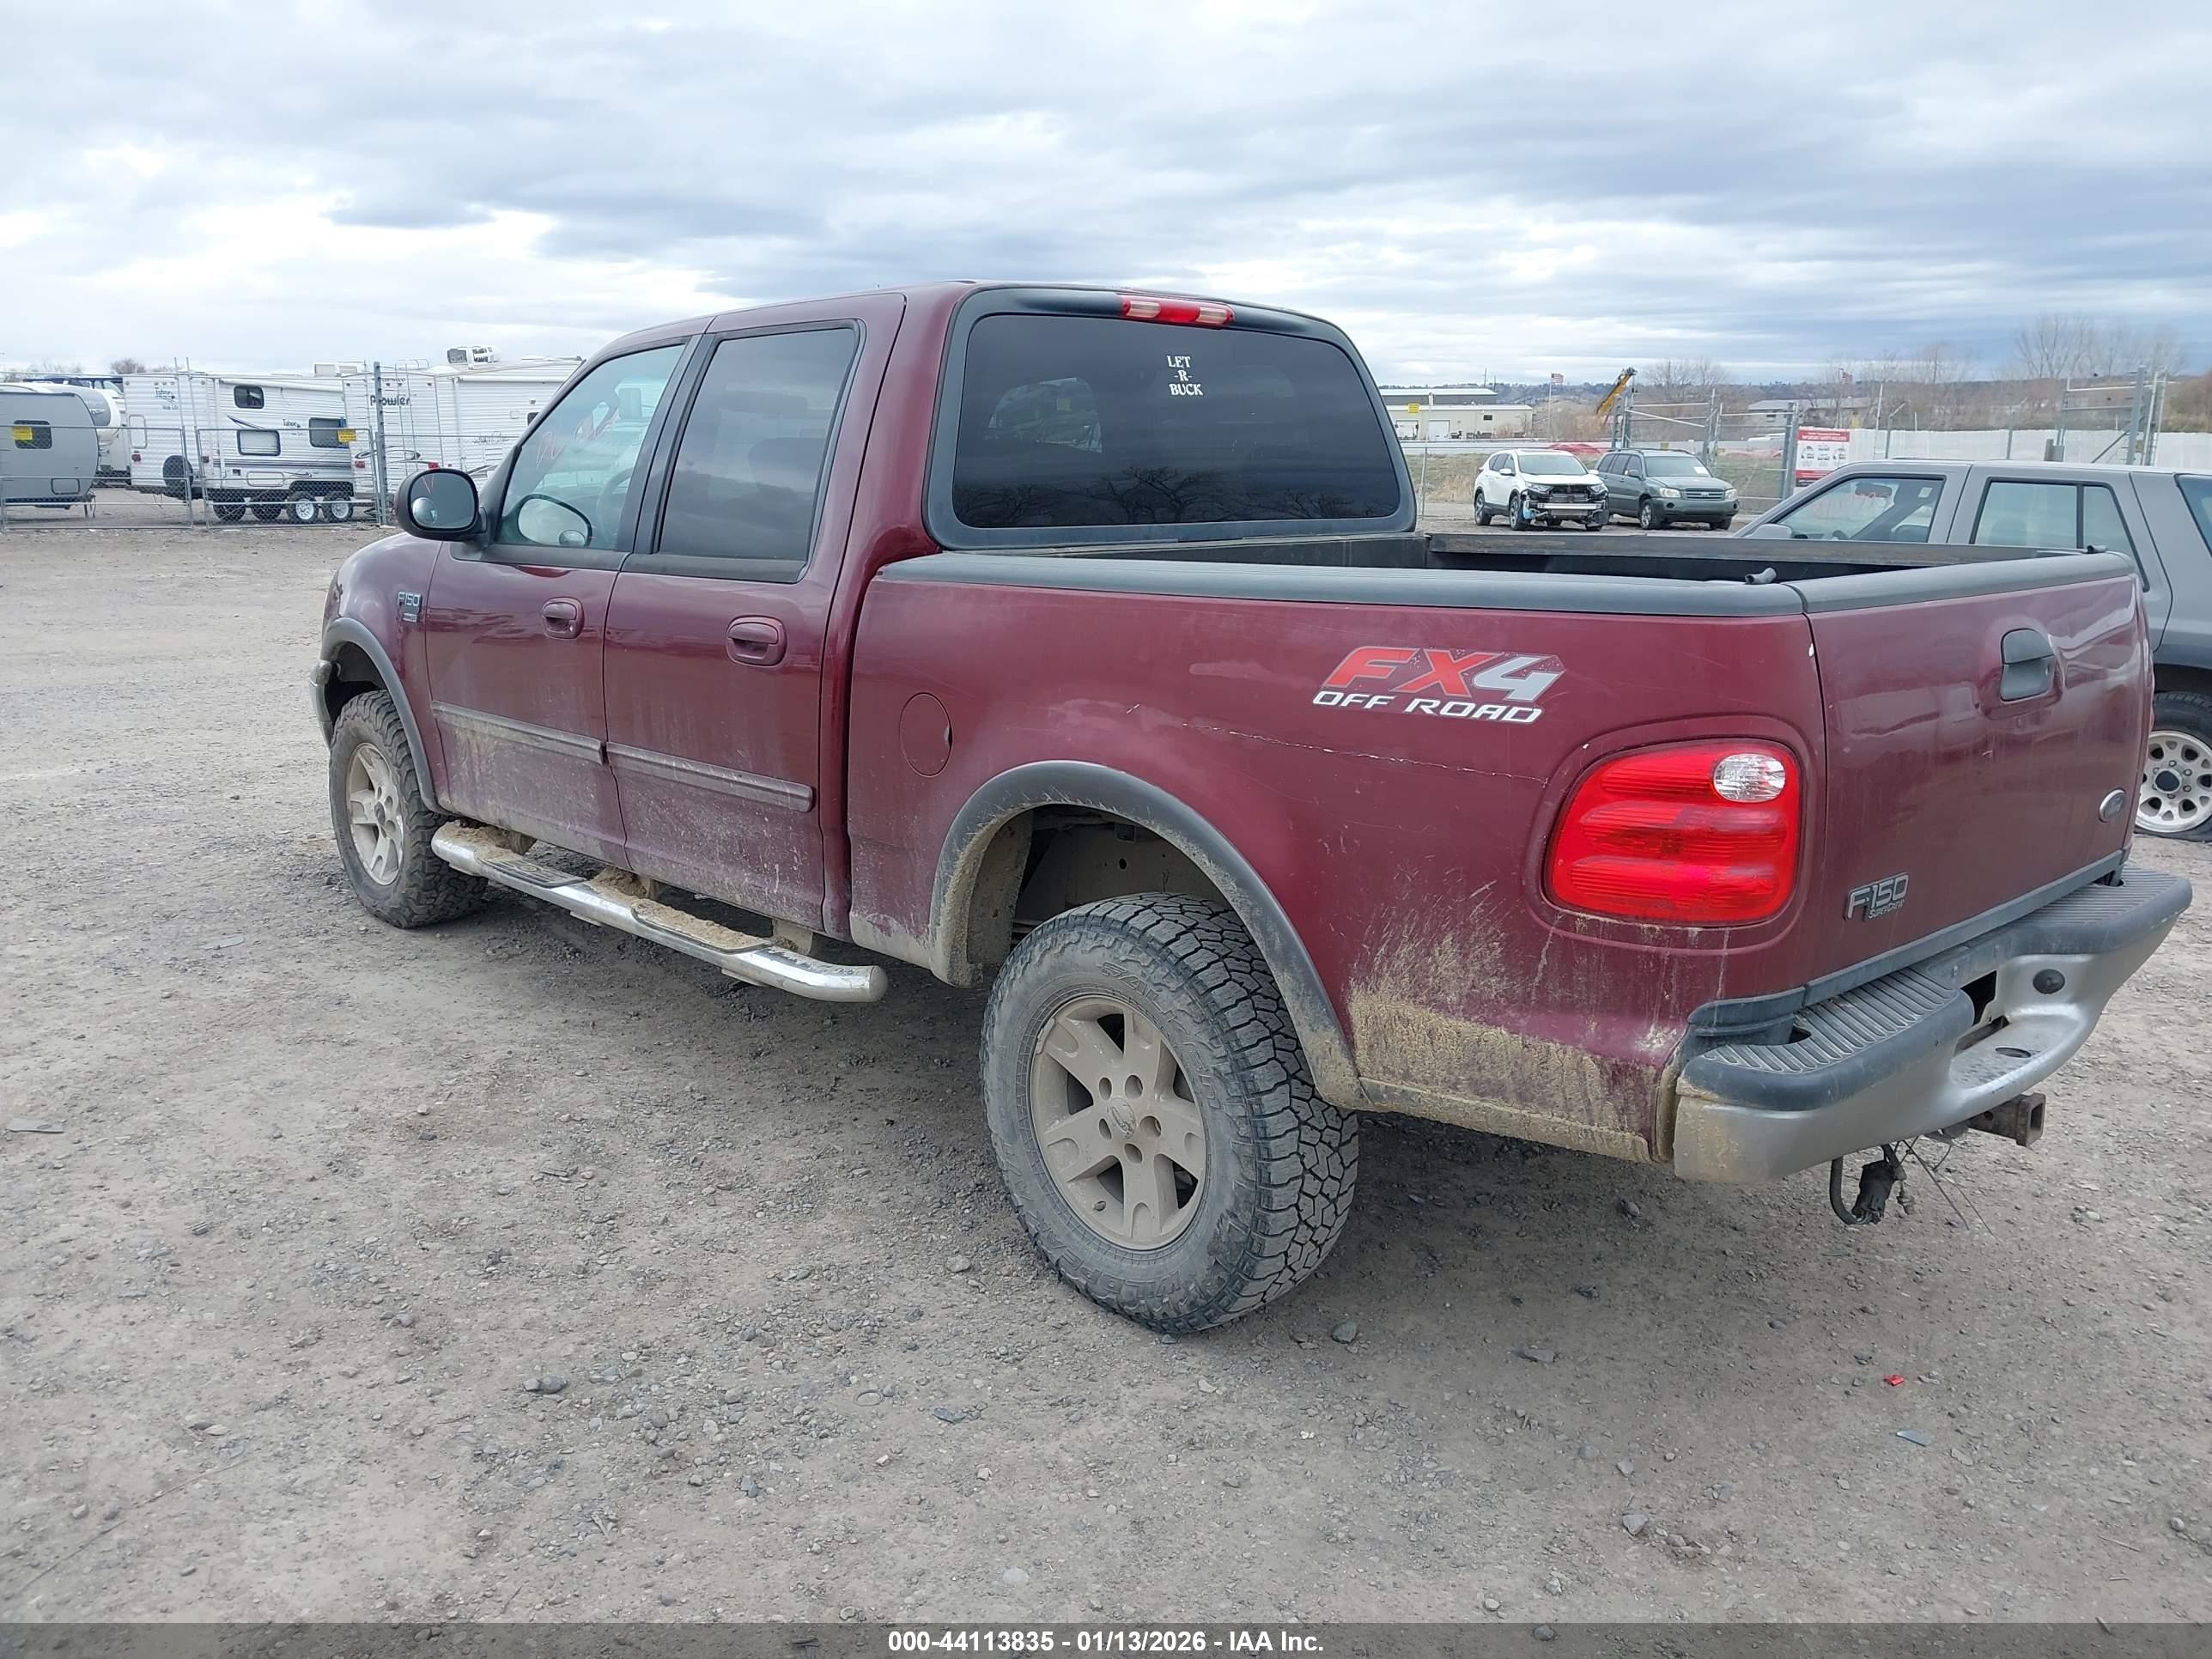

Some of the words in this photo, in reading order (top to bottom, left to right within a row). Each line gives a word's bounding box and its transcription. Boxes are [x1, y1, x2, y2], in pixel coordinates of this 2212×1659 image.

[1166, 356, 1191, 368] LET
[1169, 384, 1203, 396] BUCK
[370, 395, 410, 406] Powler
[283, 418, 297, 427] Tahoe
[1320, 645, 1566, 702] FX4
[1312, 690, 1395, 709] OFF
[1404, 697, 1544, 723] ROAD
